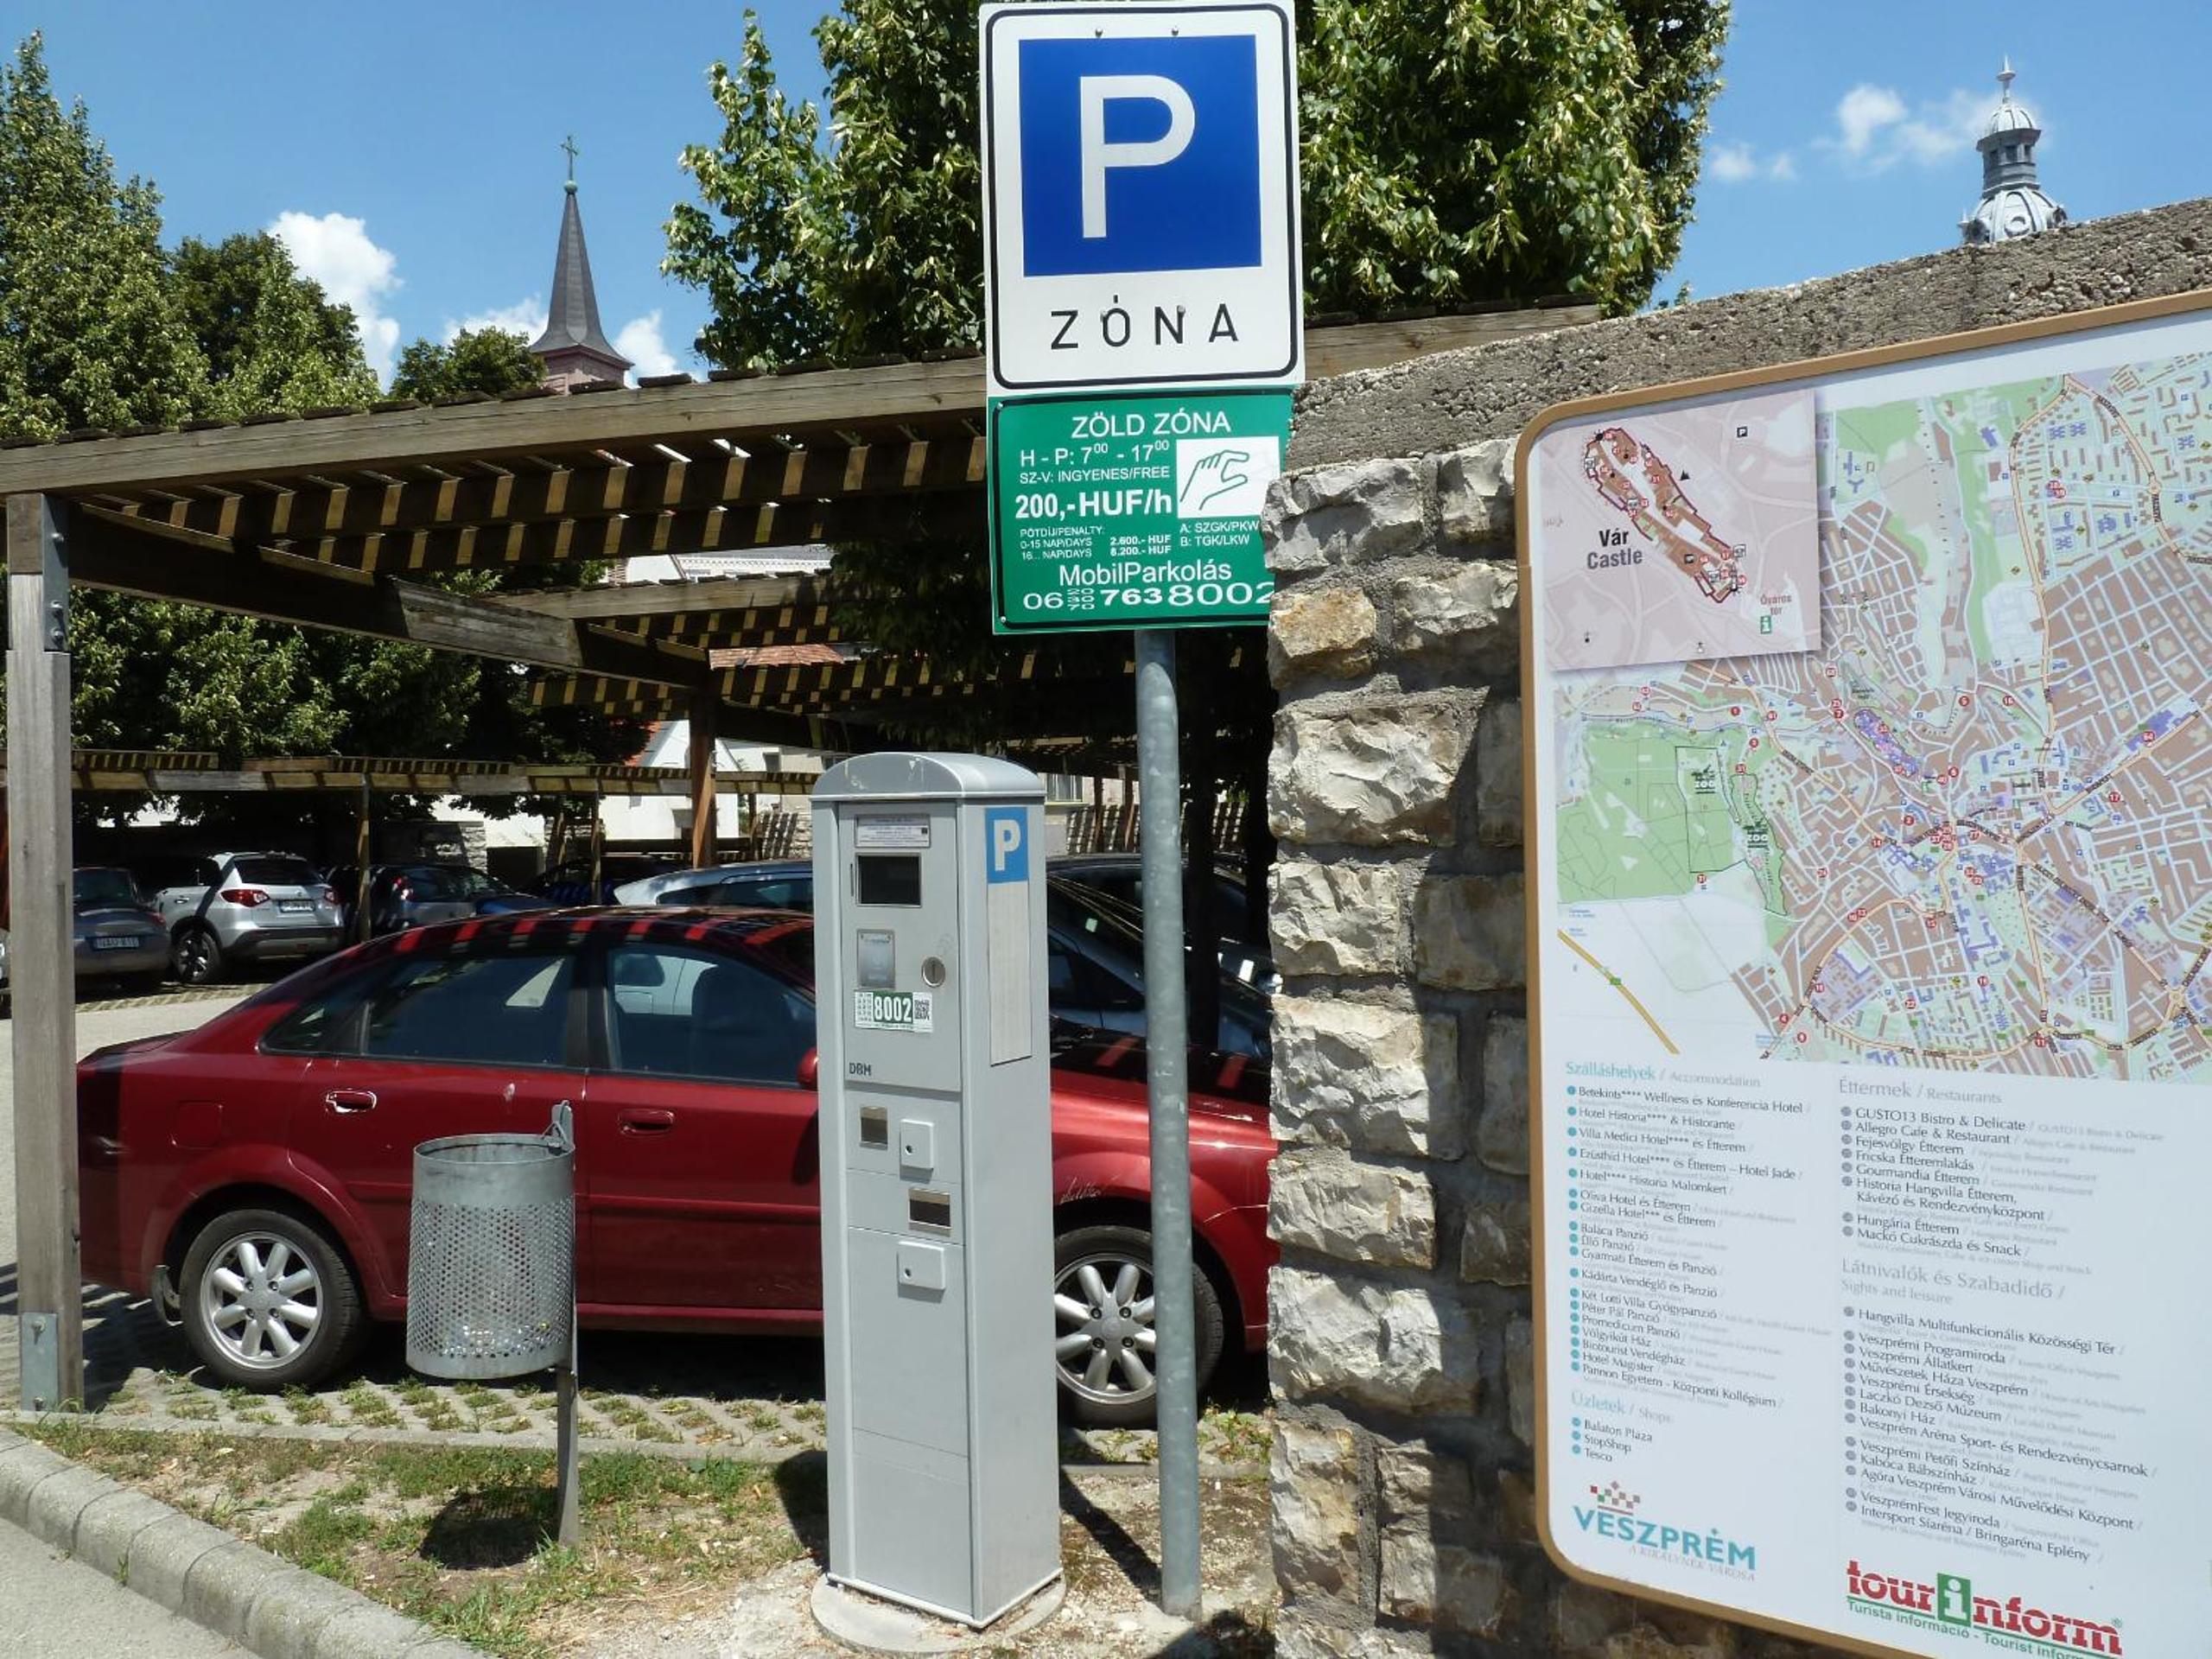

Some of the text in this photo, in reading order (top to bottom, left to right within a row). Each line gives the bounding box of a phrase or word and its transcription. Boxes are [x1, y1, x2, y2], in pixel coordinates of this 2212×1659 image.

[1080, 75, 1195, 238] P
[1051, 295, 1238, 349] ZÓNA
[1071, 408, 1231, 438] ZÖLD ZÓNA
[1020, 450, 1034, 467] H
[1054, 448, 1074, 465] P:
[1020, 467, 1170, 484] SZ-V: INGYENES/FREE
[1179, 521, 1260, 533] A: SZGK/PKW
[1020, 537, 1092, 549] 0-15 NAP/DAYS
[1148, 535, 1172, 543] HUF
[1180, 535, 1249, 546] B: TGK/LKW
[1599, 527, 1629, 547] Vár
[1042, 549, 1092, 559] NAP/DAYS
[1148, 545, 1172, 554] HUF
[1587, 548, 1643, 569] Castle
[1060, 560, 1232, 586] MobilParkolás
[1023, 593, 1064, 610] 06
[994, 819, 1021, 872] P
[874, 996, 912, 1022] 8002
[1926, 1088, 2003, 1104] Restaurants
[1772, 1100, 1803, 1114] Hotel
[1855, 1107, 1916, 1124] GUSTO13
[1920, 1113, 1956, 1126] Bistro
[1974, 1116, 2026, 1132] Delicate
[1855, 1122, 1898, 1138] Allegro
[1946, 1128, 2011, 1145] Restaurant
[1984, 1242, 2023, 1257] Snack
[1584, 1418, 1653, 1442] Balaton Plaza
[1584, 1447, 1613, 1462] Tesco
[1848, 1600, 1892, 1622] Turista
[1985, 1631, 2034, 1655] Tourist
